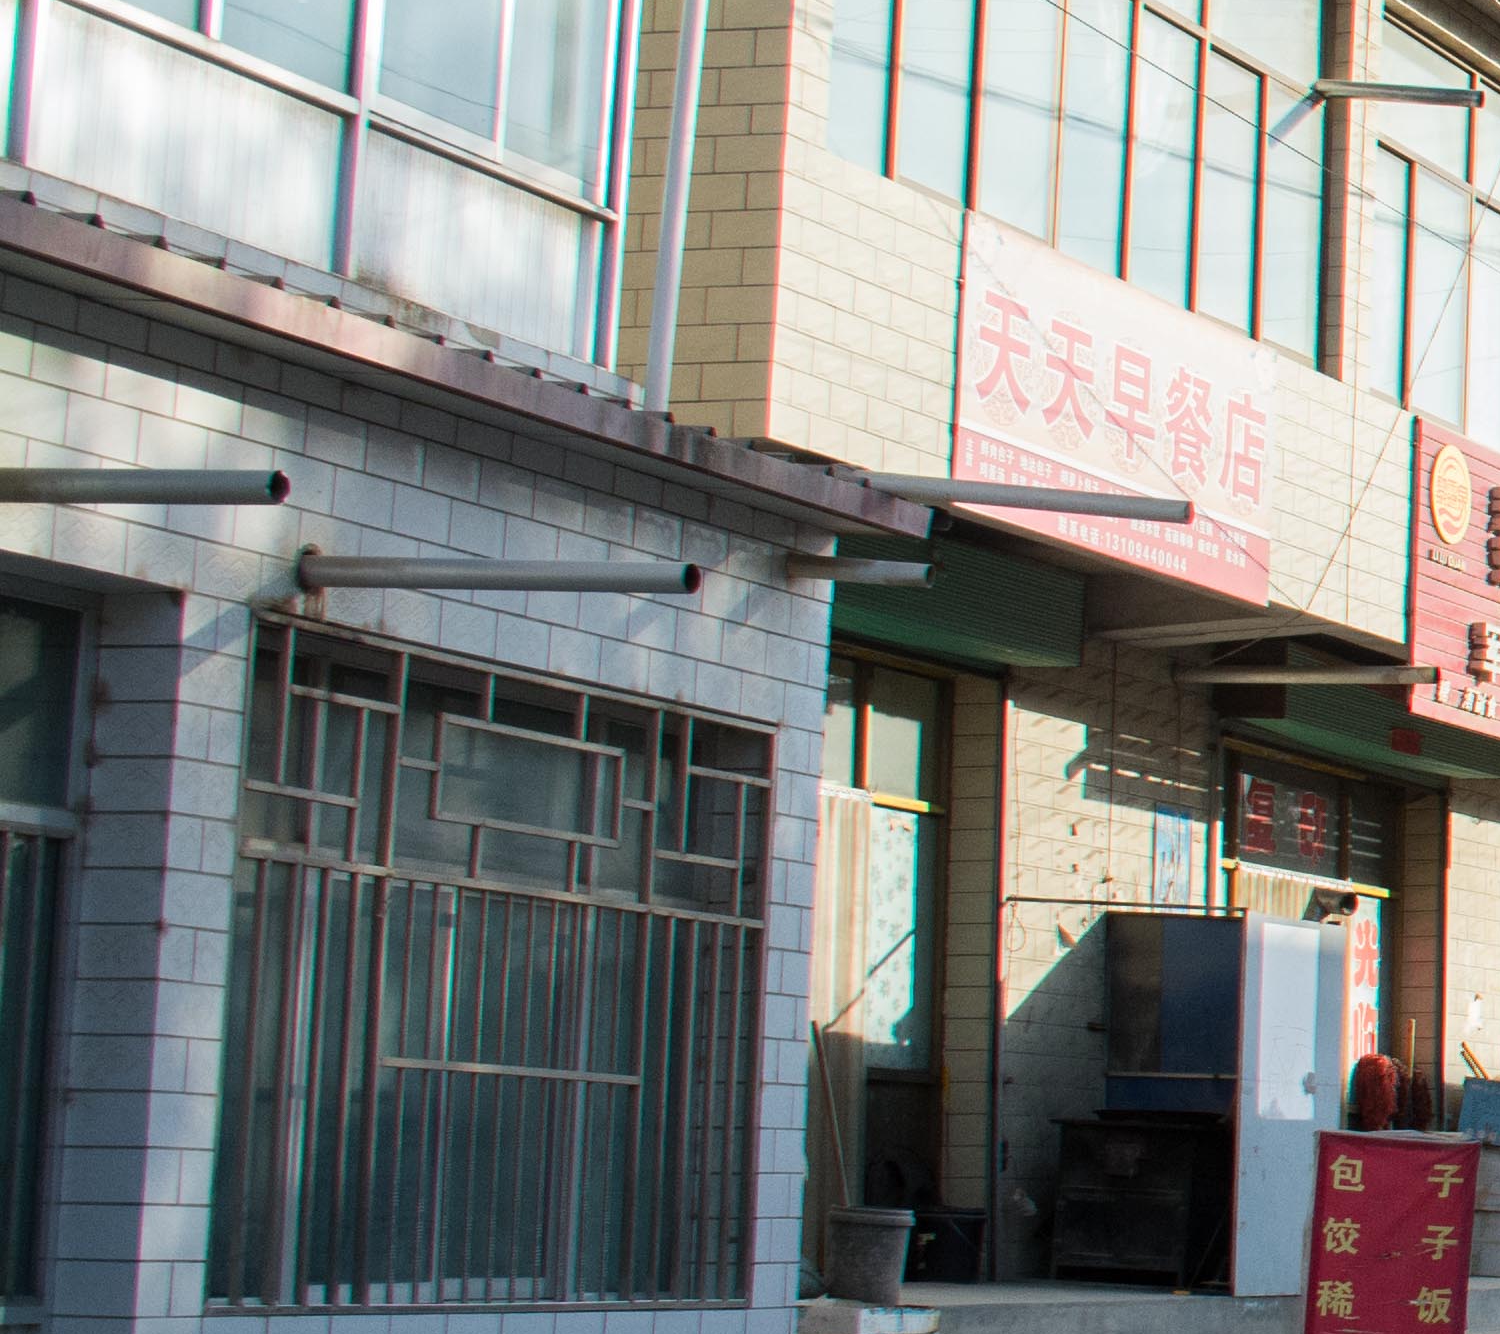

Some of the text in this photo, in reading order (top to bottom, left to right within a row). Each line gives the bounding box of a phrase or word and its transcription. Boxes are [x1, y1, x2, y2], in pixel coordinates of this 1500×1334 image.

[974, 289, 1268, 509] 天天早餐店
[1246, 777, 1327, 866] 复印
[1329, 1154, 1464, 1199] 包子
[1322, 1217, 1459, 1262] 饺子
[1316, 1280, 1452, 1325] 稀饭
